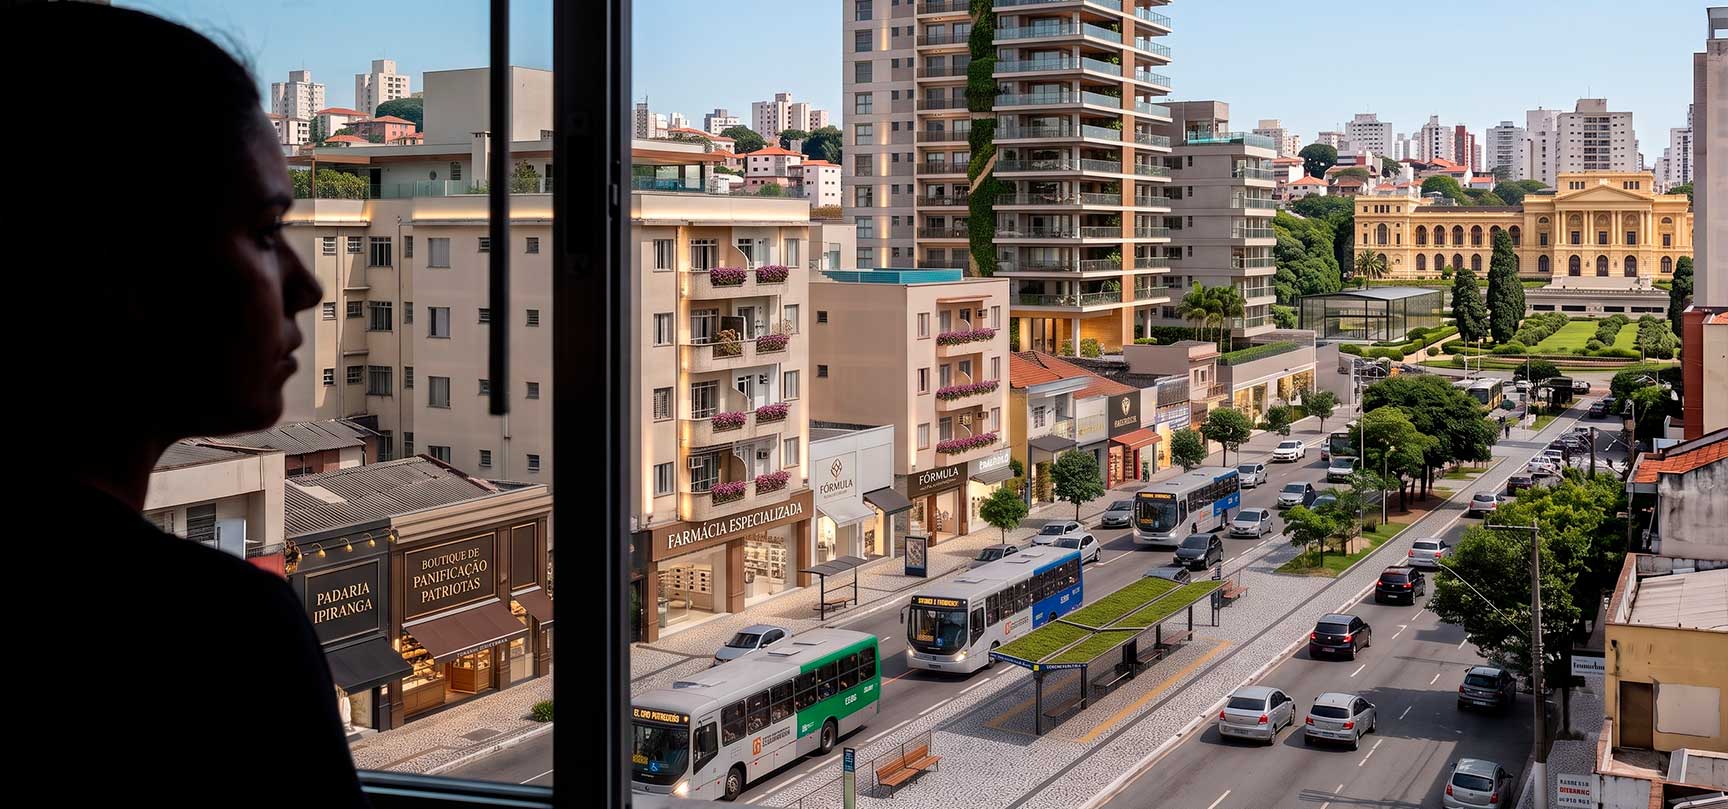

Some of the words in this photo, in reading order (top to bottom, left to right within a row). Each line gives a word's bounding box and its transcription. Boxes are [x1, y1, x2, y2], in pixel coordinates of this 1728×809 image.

[819, 479, 853, 495] FÓRMULA
[919, 467, 959, 485] FÓRMULA
[668, 521, 727, 549] FARMÁCIA
[729, 502, 803, 533] ESPECIALIZADA
[422, 550, 467, 570] BOUTIQUE
[468, 547, 480, 559] DE
[413, 559, 488, 589] PANIFICAÇÃO
[317, 582, 370, 606] PADARIA
[421, 577, 481, 603] PATRIOTAS
[314, 598, 373, 624] IPIRANGA
